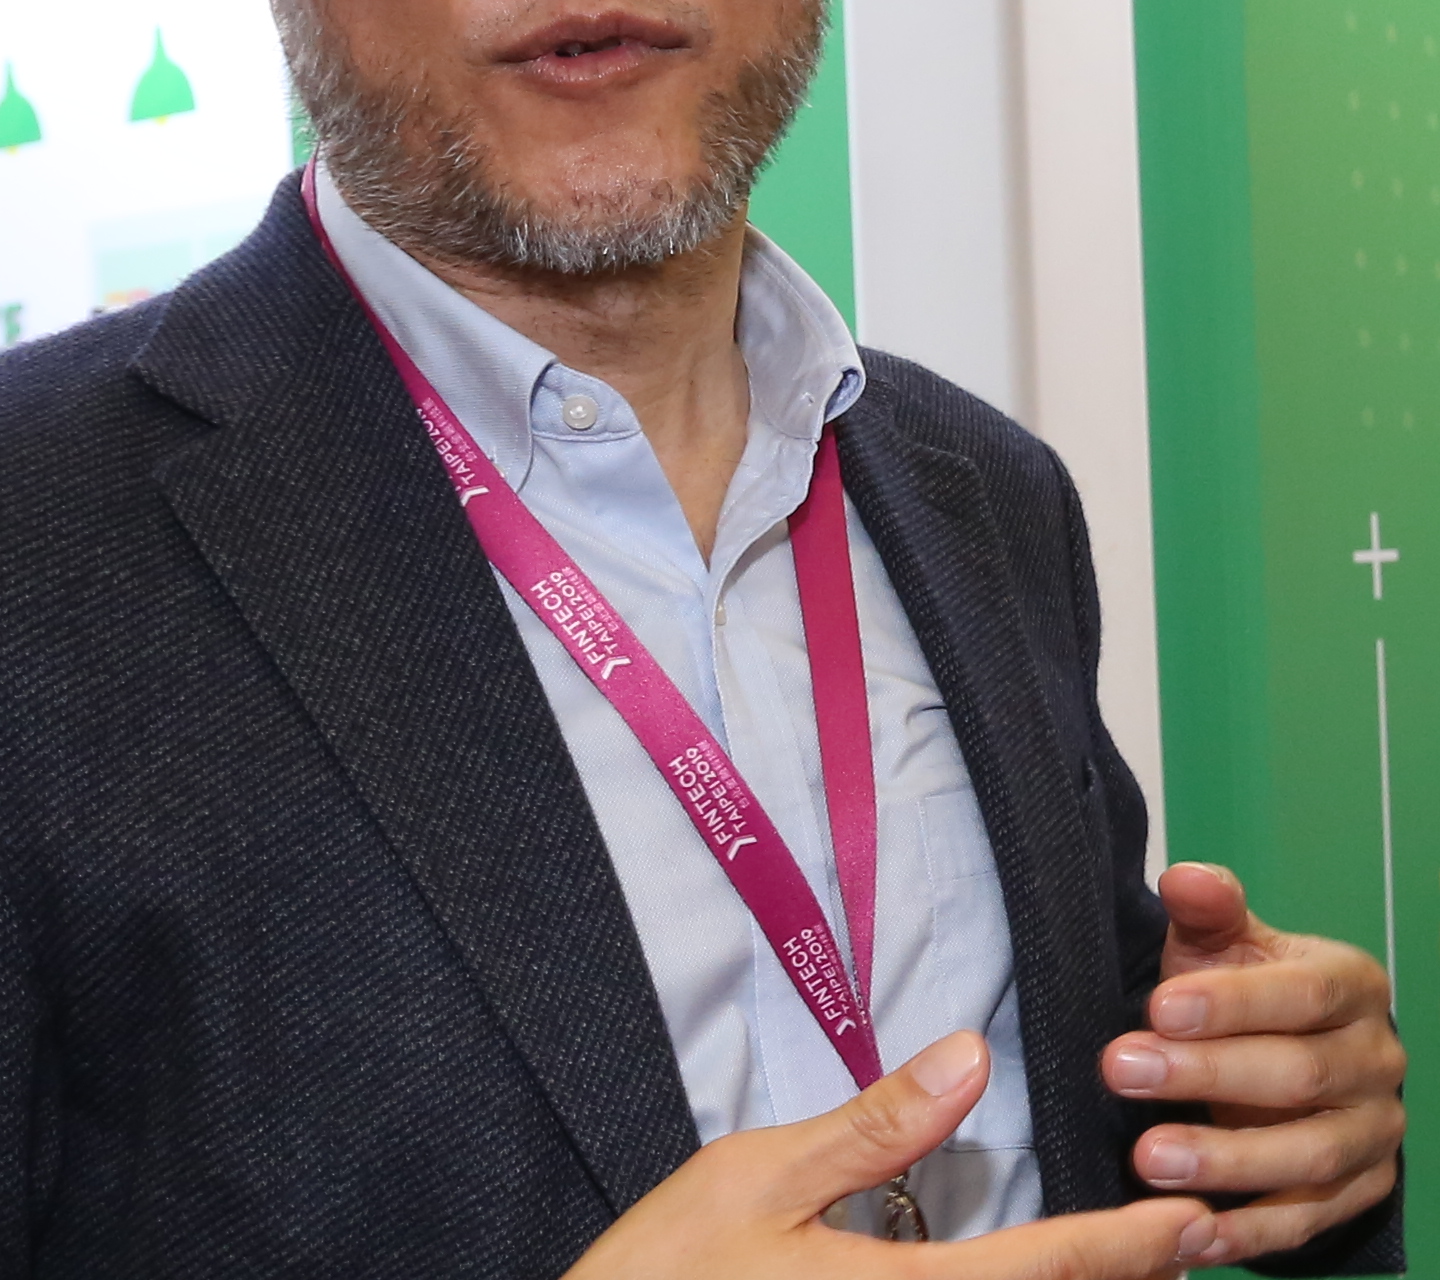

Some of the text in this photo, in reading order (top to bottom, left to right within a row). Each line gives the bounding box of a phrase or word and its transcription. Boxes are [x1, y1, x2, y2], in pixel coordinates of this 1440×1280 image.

[531, 582, 606, 666] FINTECH
[668, 755, 732, 846] FINTECH
[783, 937, 841, 1023] FINTECH
